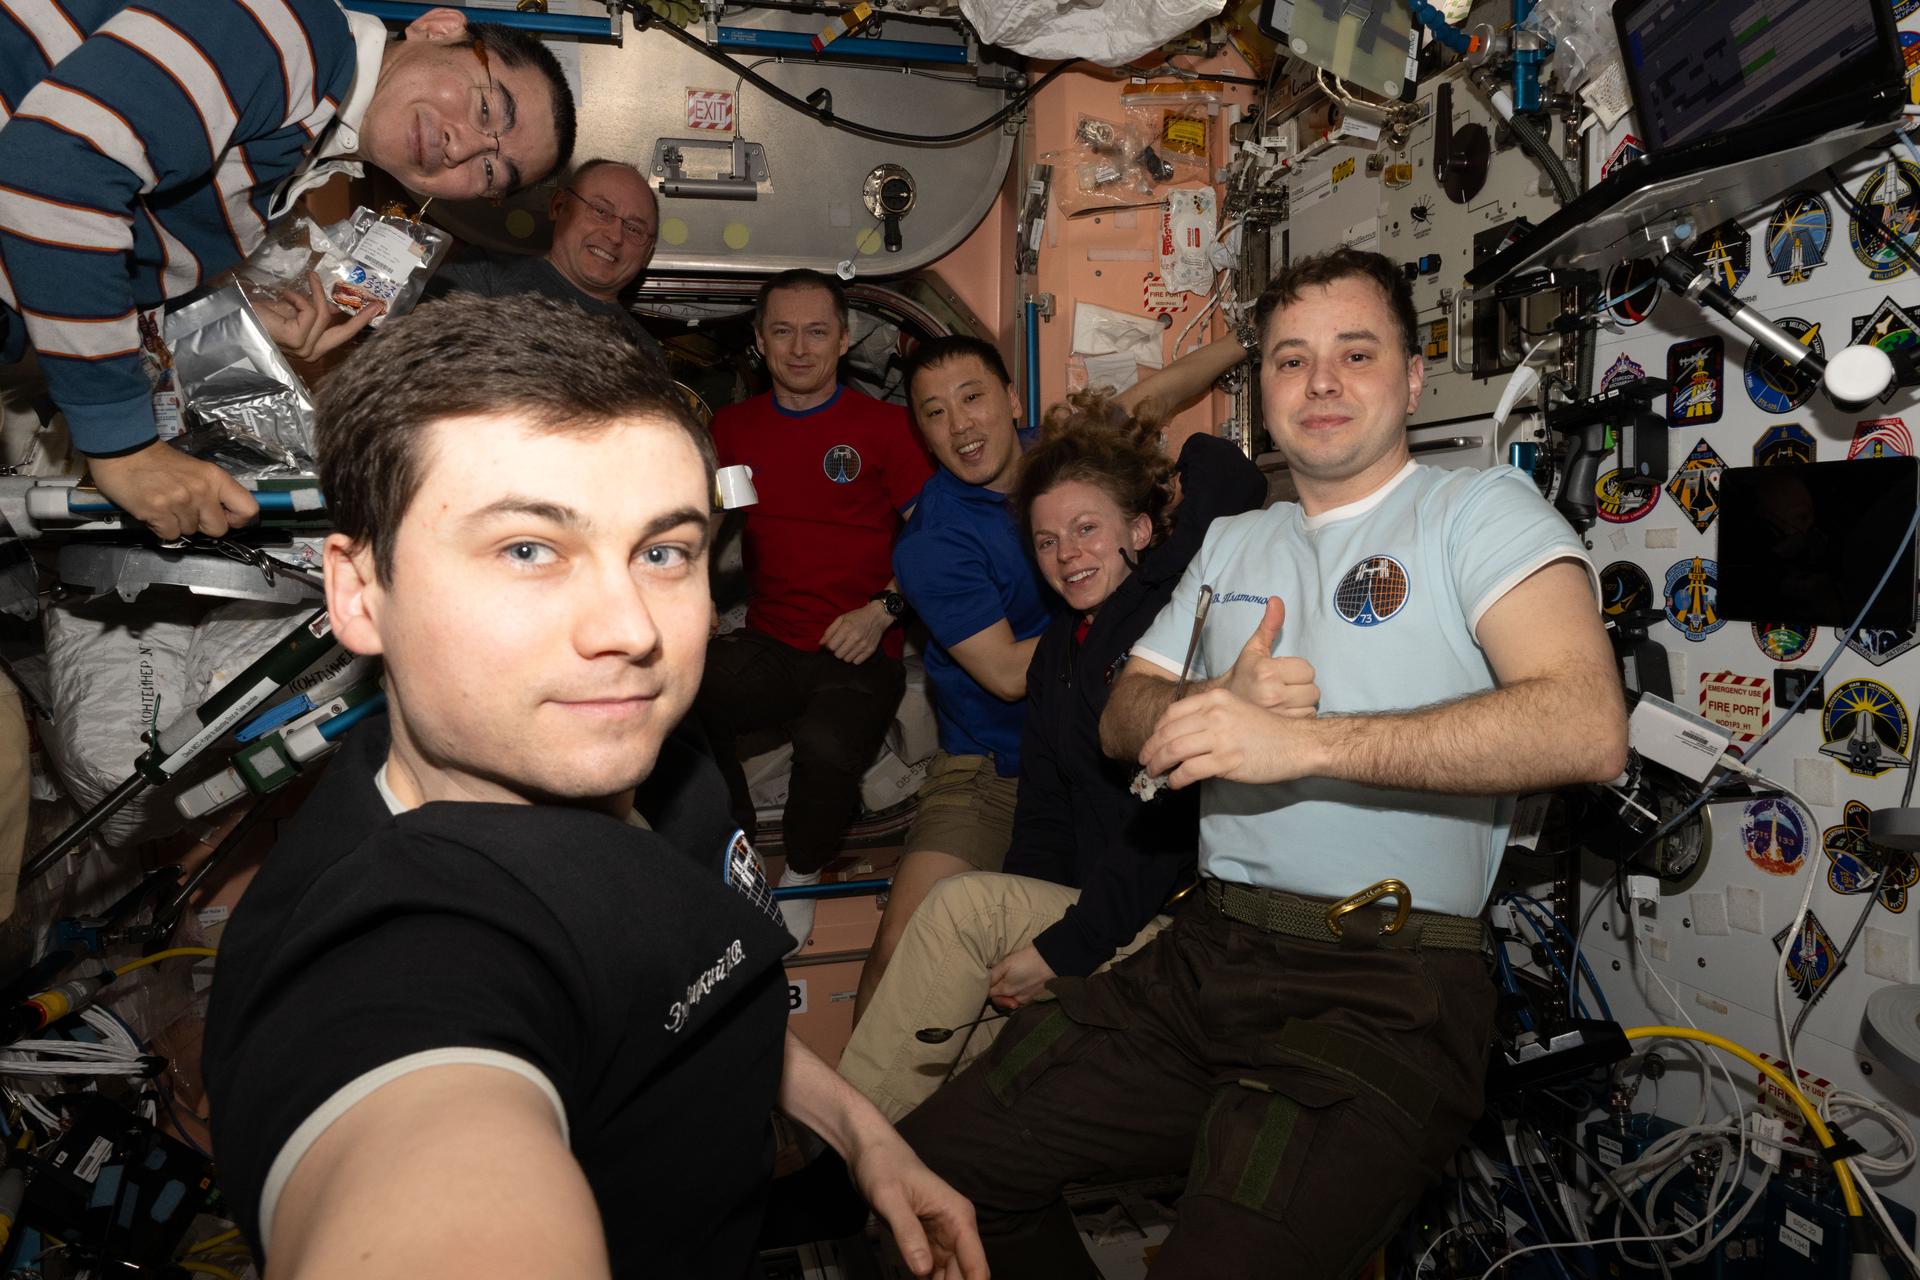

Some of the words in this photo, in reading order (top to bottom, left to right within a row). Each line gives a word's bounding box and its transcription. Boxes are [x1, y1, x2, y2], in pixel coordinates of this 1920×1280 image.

[695, 99, 726, 123] EXIT
[1874, 267, 1903, 279] WILLIAMS
[1789, 321, 1808, 332] MELROY
[1813, 338, 1822, 354] ZAMK
[1221, 591, 1269, 605] Платоно
[1361, 614, 1373, 624] 73
[1688, 632, 1704, 640] STOTT
[1885, 641, 1912, 659] PATRICK
[288, 650, 354, 694] КОНТЕЙНЕ
[140, 660, 155, 725] КОНТЕЙНЕР
[1708, 685, 1747, 695] EMERGENCY
[1748, 690, 1762, 698] USE
[1868, 683, 1896, 702] ANTONELLI
[1708, 700, 1730, 713] FIRE
[1733, 704, 1761, 716] PORT
[181, 746, 194, 758] Check
[1778, 836, 1795, 846] 133
[1768, 1084, 1792, 1104] FIRE
